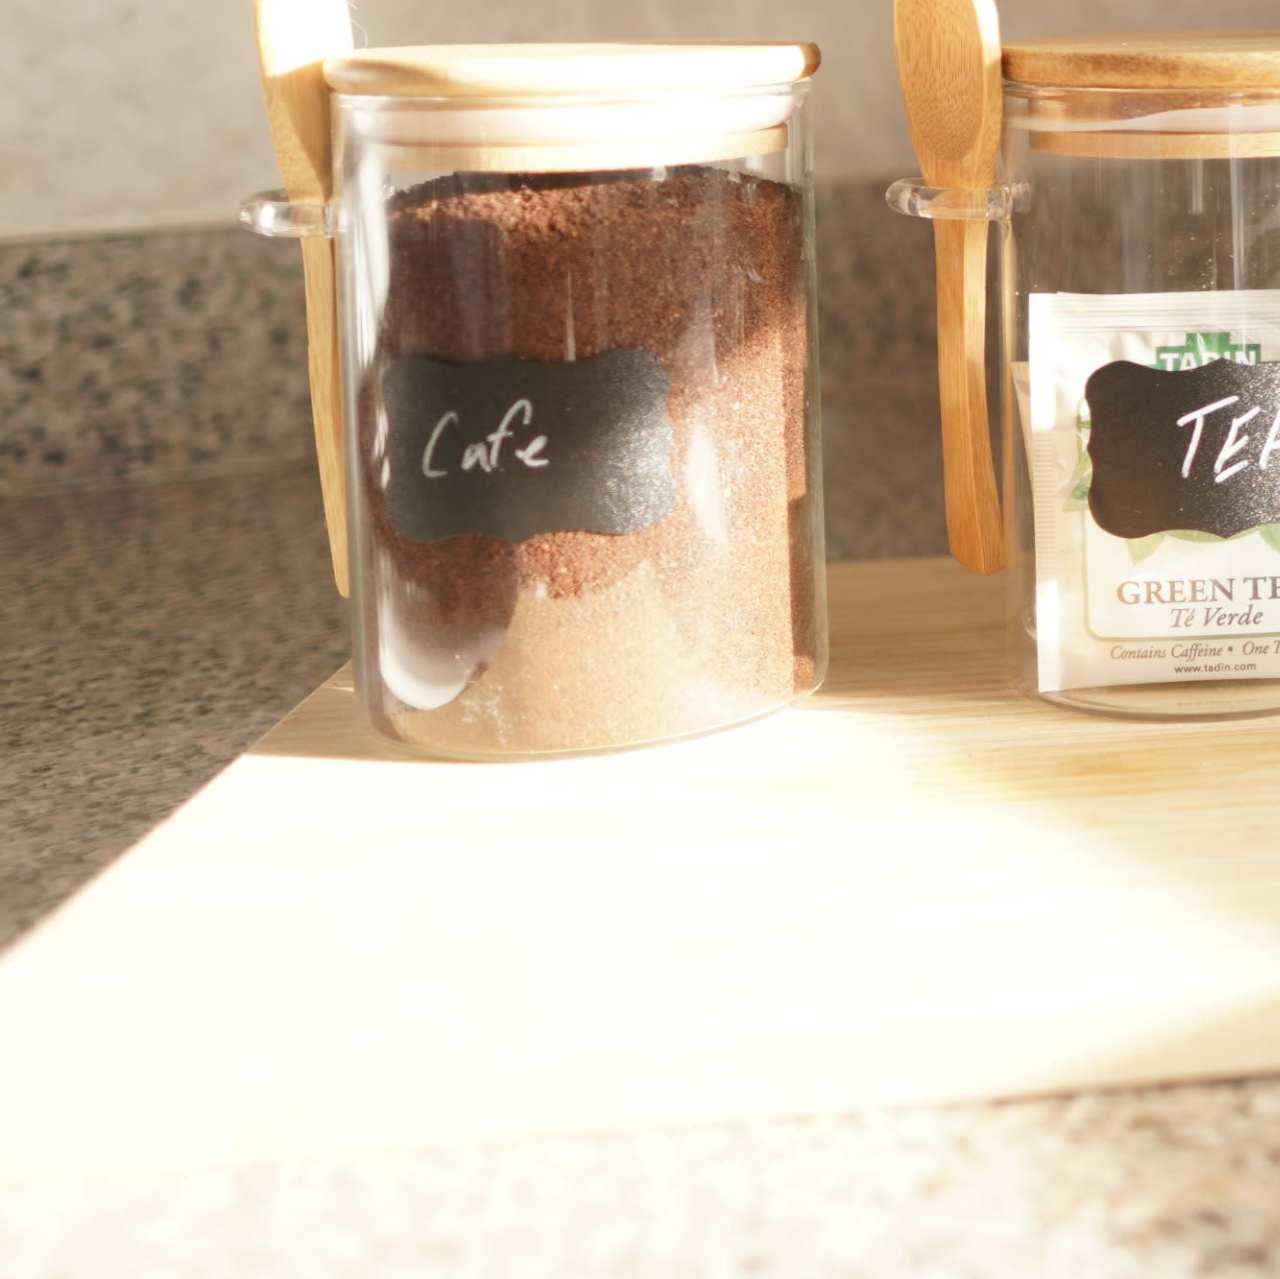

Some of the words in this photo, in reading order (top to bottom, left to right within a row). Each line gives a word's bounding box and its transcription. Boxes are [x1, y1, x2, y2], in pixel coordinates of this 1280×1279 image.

[1116, 578, 1236, 605] GREEN
[1169, 607, 1195, 628] Té
[1202, 604, 1264, 627] Verde
[1110, 643, 1167, 660] Contains
[1170, 641, 1224, 663] Caffeine
[1242, 640, 1269, 656] One
[1174, 662, 1257, 674] www.tadin.com
